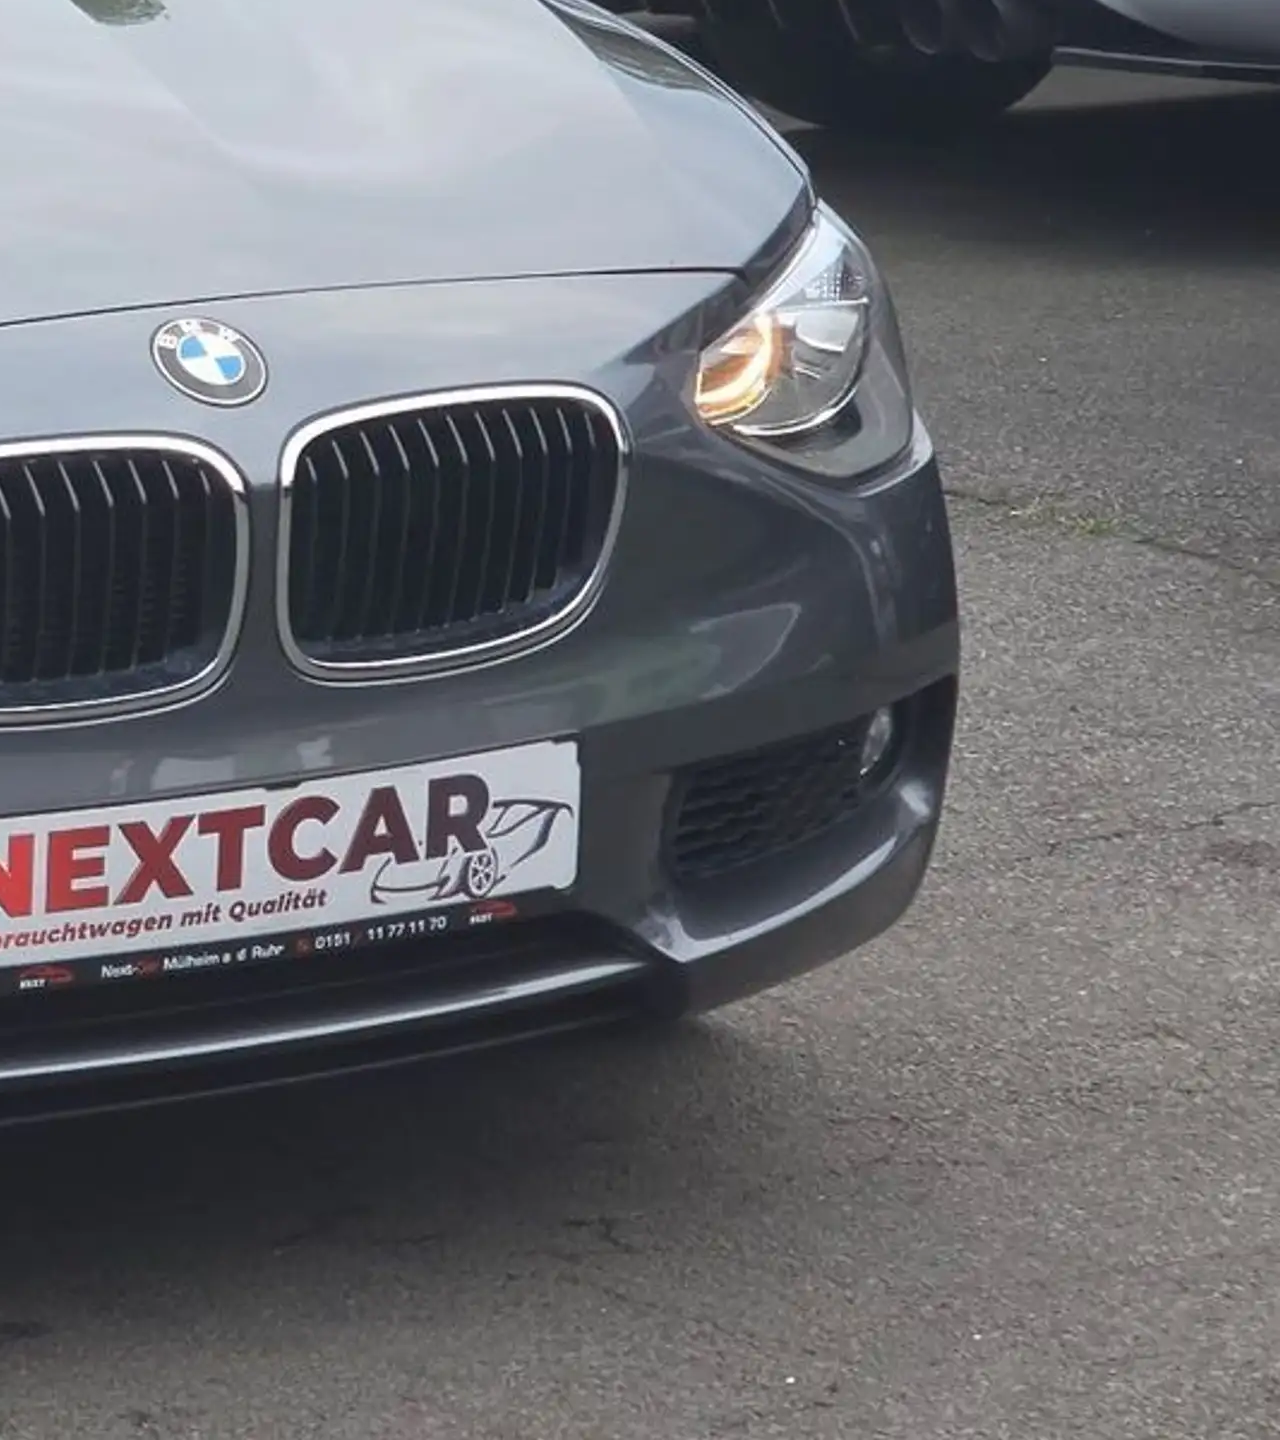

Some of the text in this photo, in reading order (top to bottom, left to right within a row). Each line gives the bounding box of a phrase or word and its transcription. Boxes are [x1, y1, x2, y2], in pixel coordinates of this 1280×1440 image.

[180, 903, 222, 928] mit
[228, 889, 328, 923] Qualität
[163, 951, 221, 971] Mülheim
[315, 931, 351, 949] 0151
